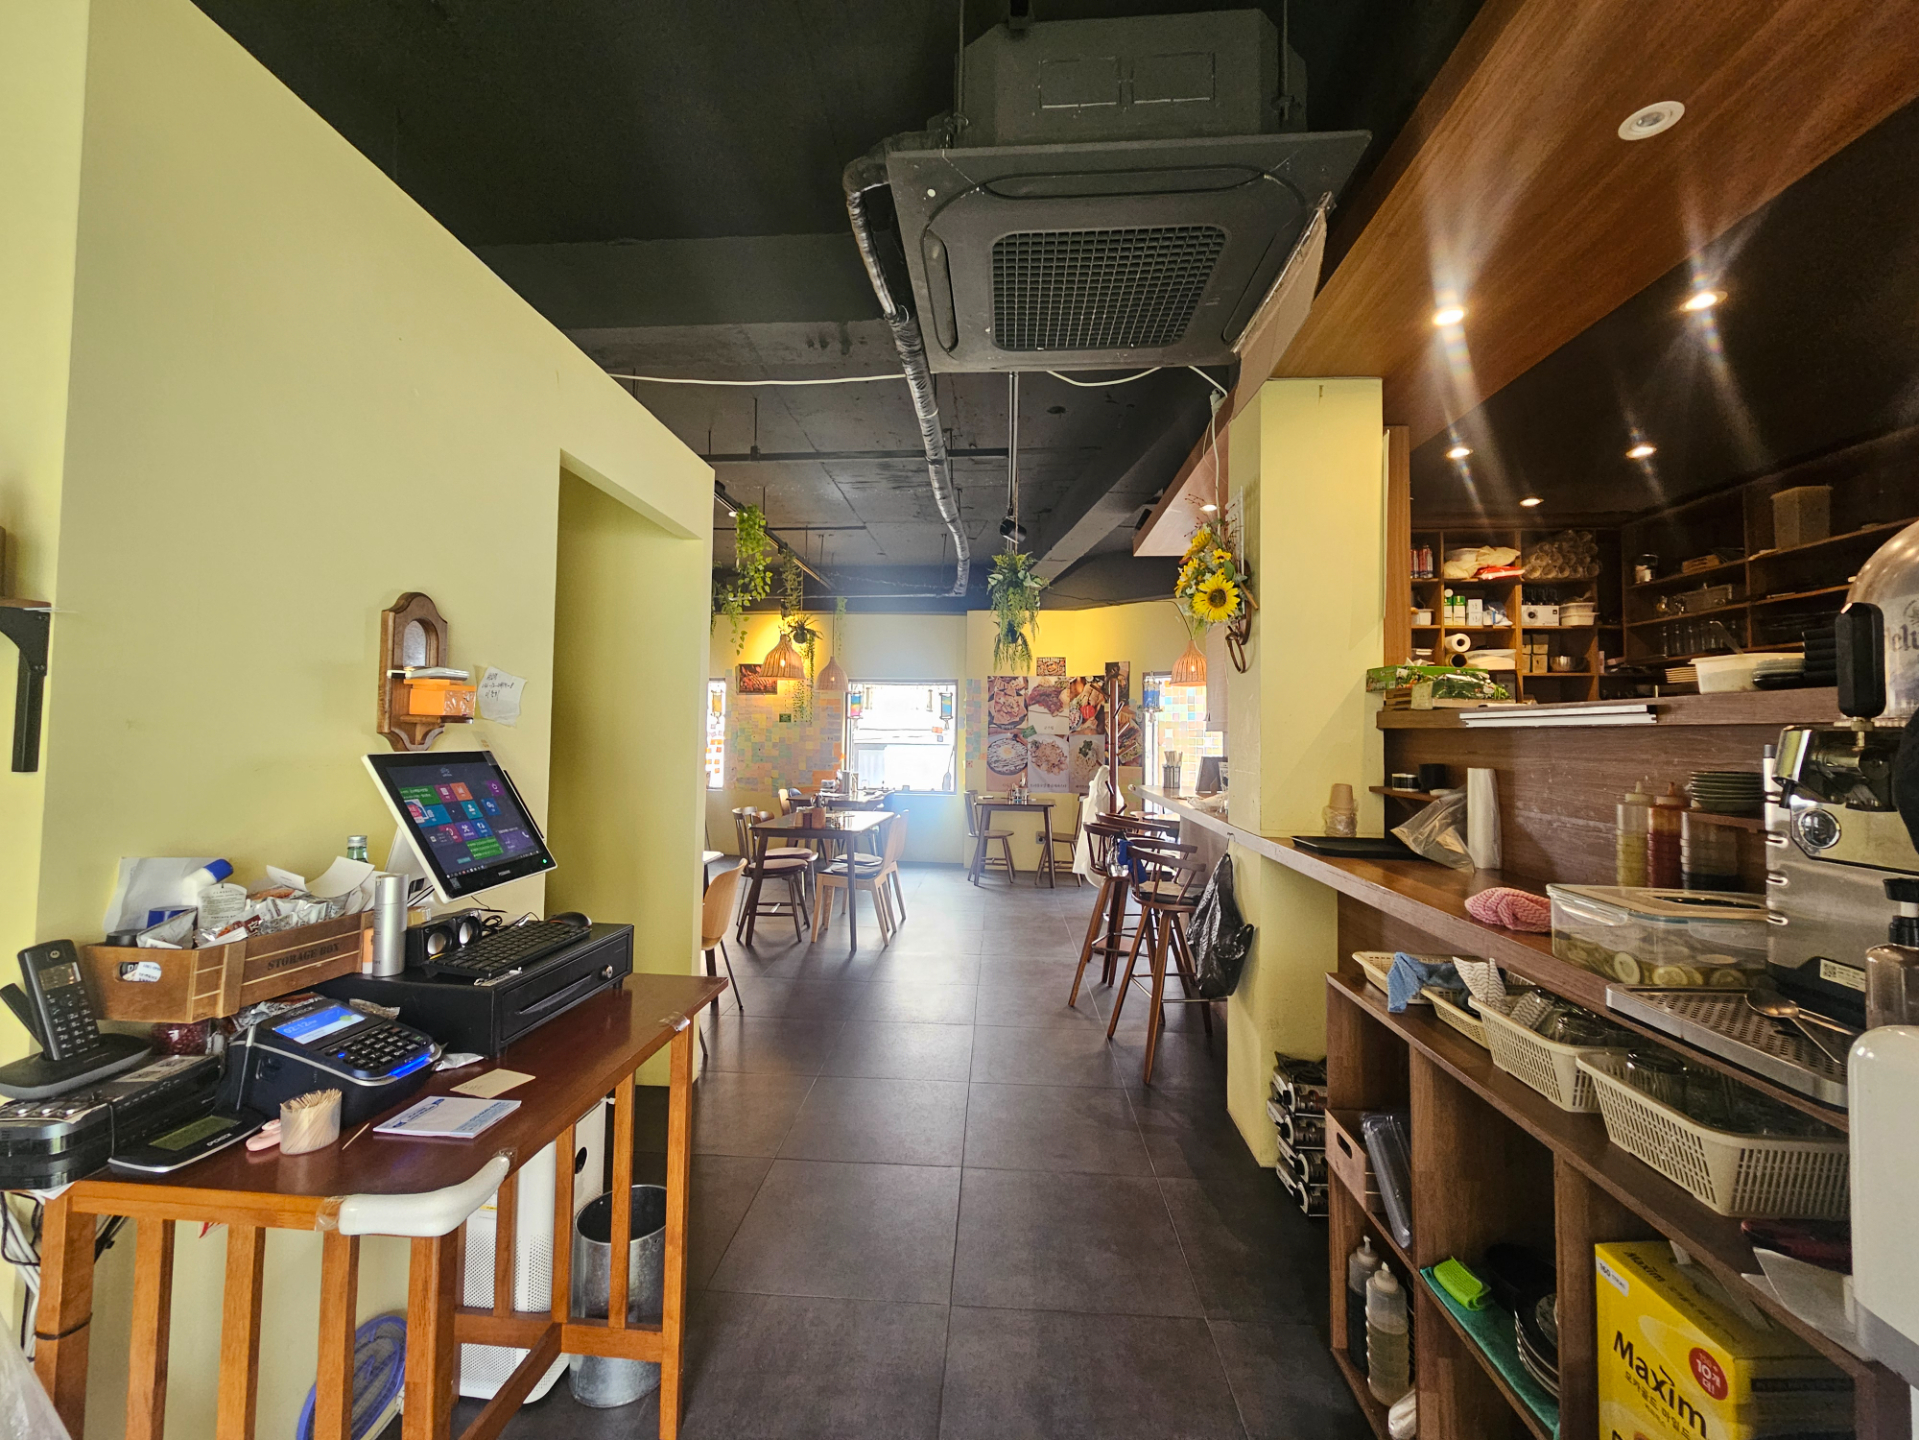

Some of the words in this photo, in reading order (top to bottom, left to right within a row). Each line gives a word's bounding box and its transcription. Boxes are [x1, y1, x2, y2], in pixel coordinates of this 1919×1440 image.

[267, 948, 317, 970] STORAGE
[319, 942, 340, 956] BOX
[1623, 1251, 1666, 1282] Maxim
[1613, 1330, 1706, 1439] Maxim
